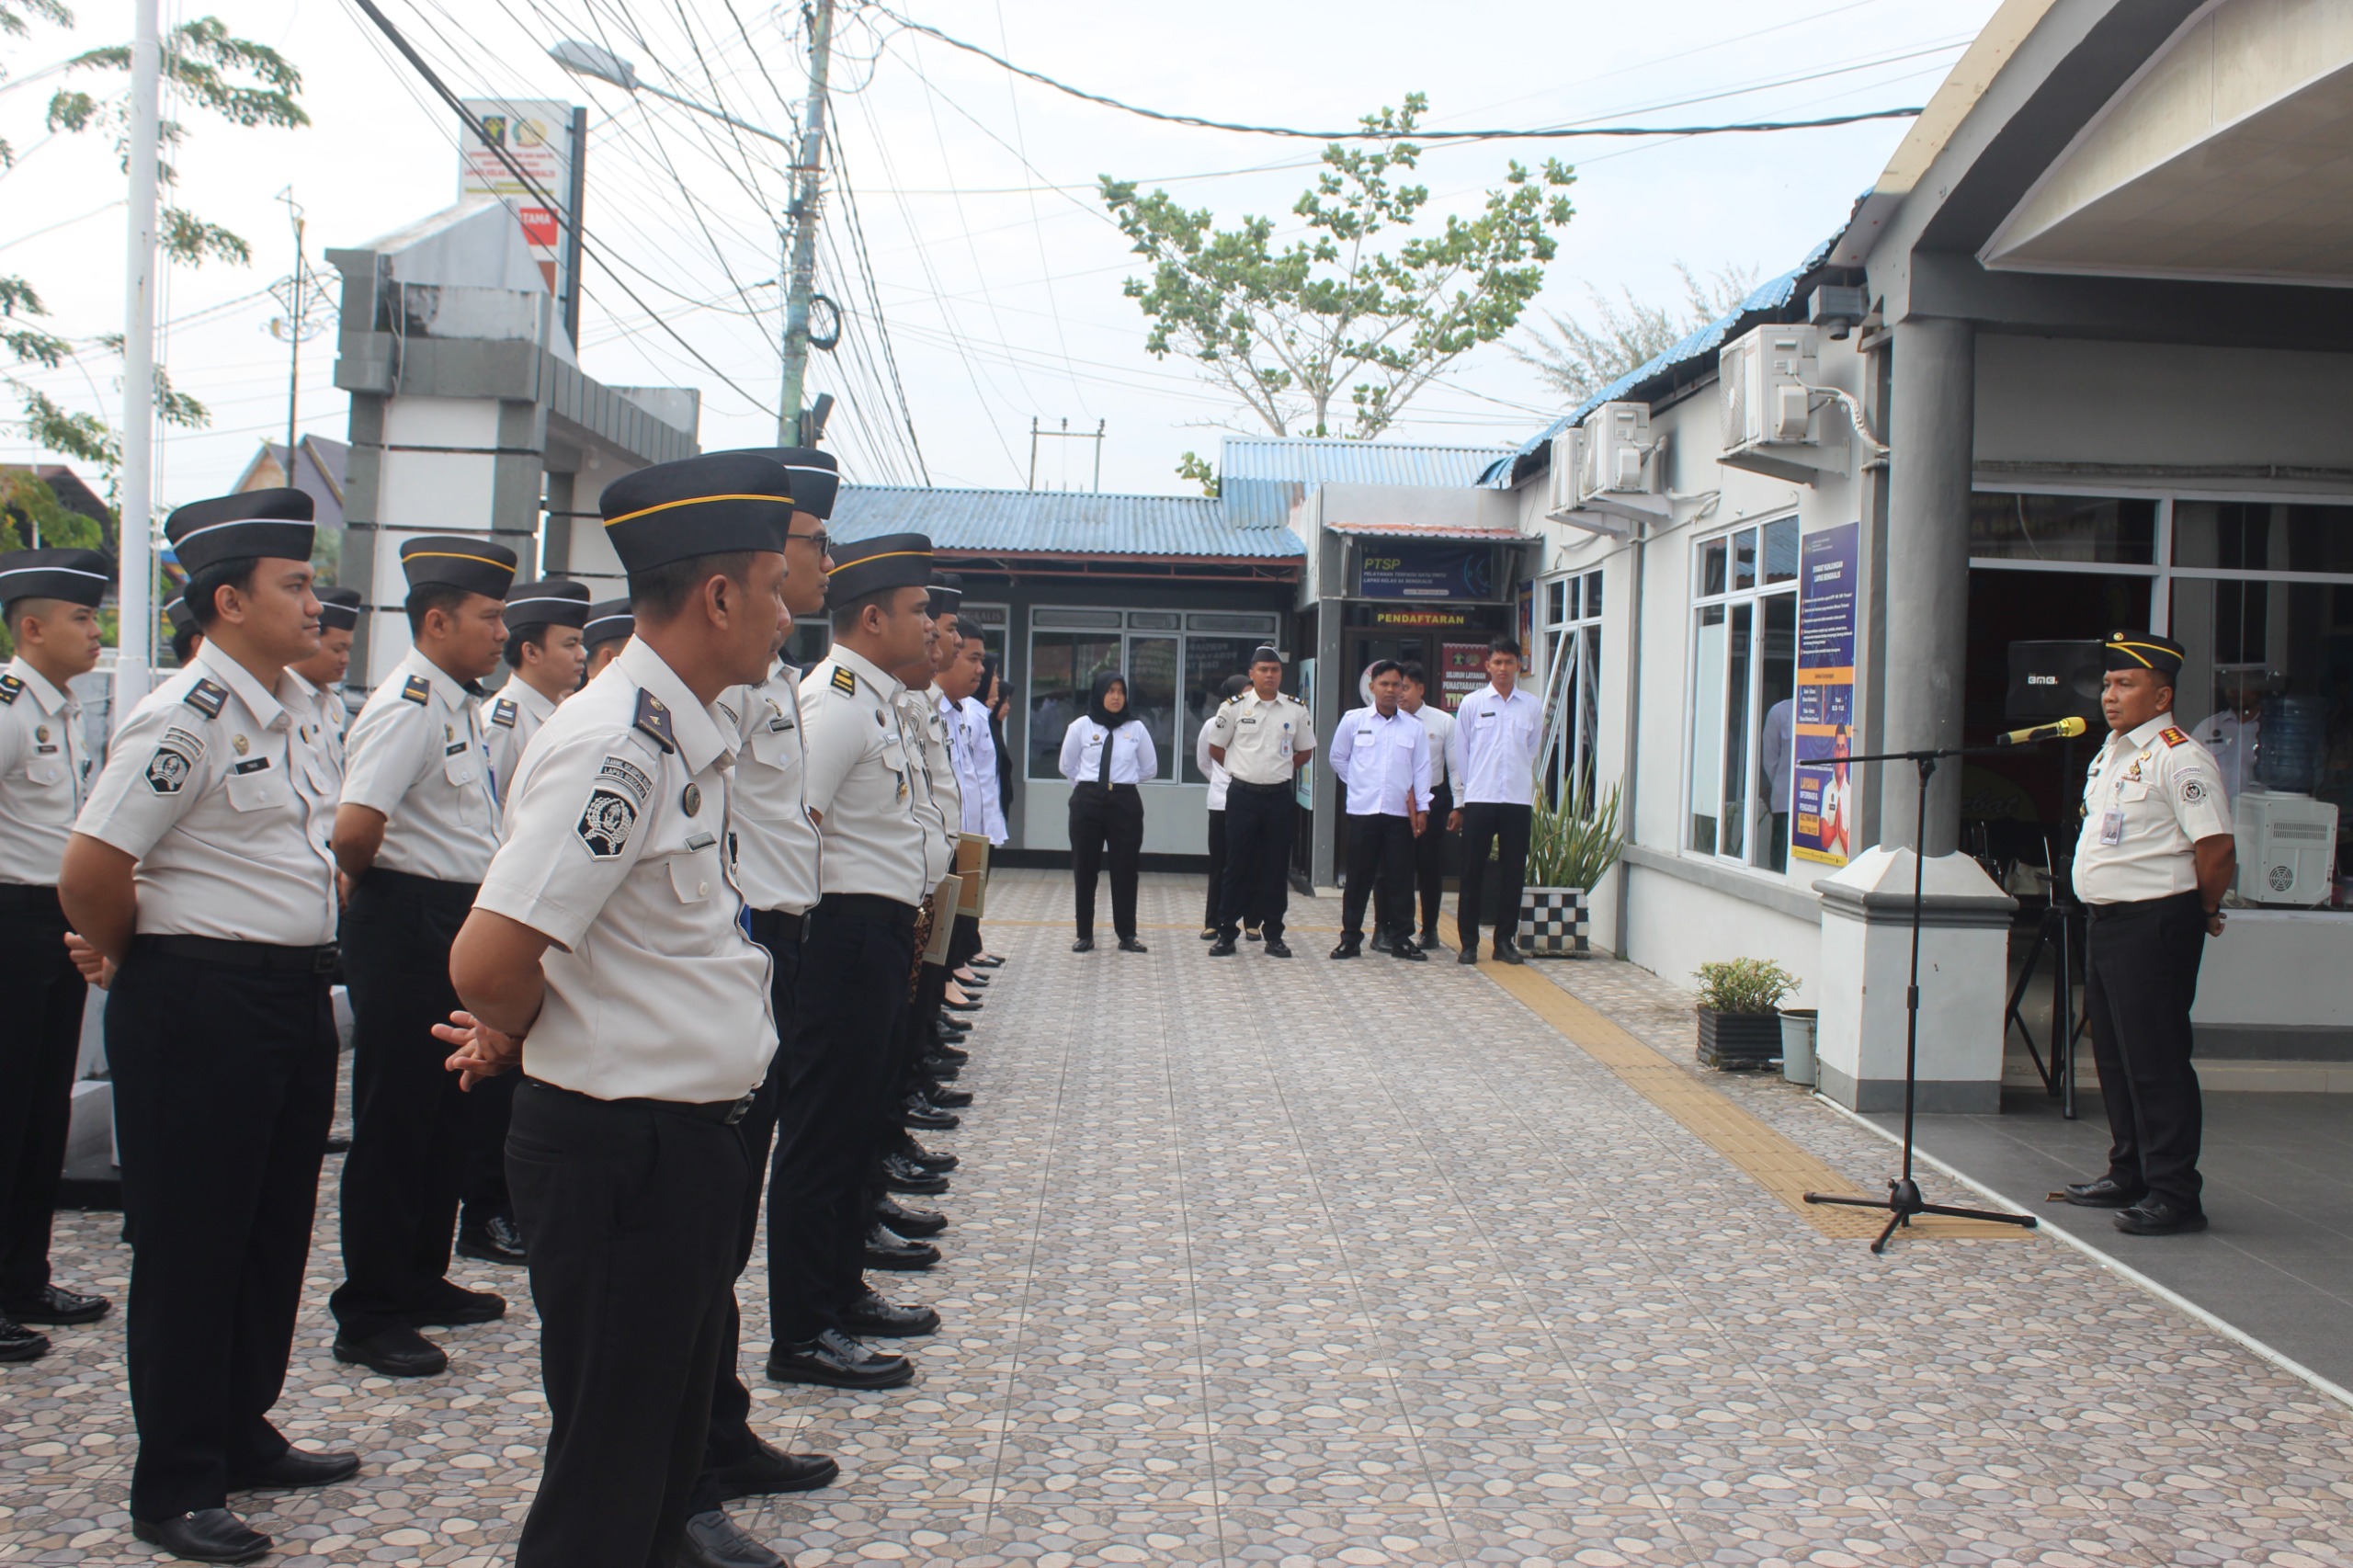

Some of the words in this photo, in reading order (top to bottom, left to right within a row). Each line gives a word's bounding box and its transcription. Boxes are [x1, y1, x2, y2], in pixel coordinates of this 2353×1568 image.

[1364, 558, 1401, 570] PTSP
[1377, 613, 1464, 624] PENDAFTARAN
[1466, 671, 1486, 679] LAYANAN
[605, 767, 624, 778] LAPAS
